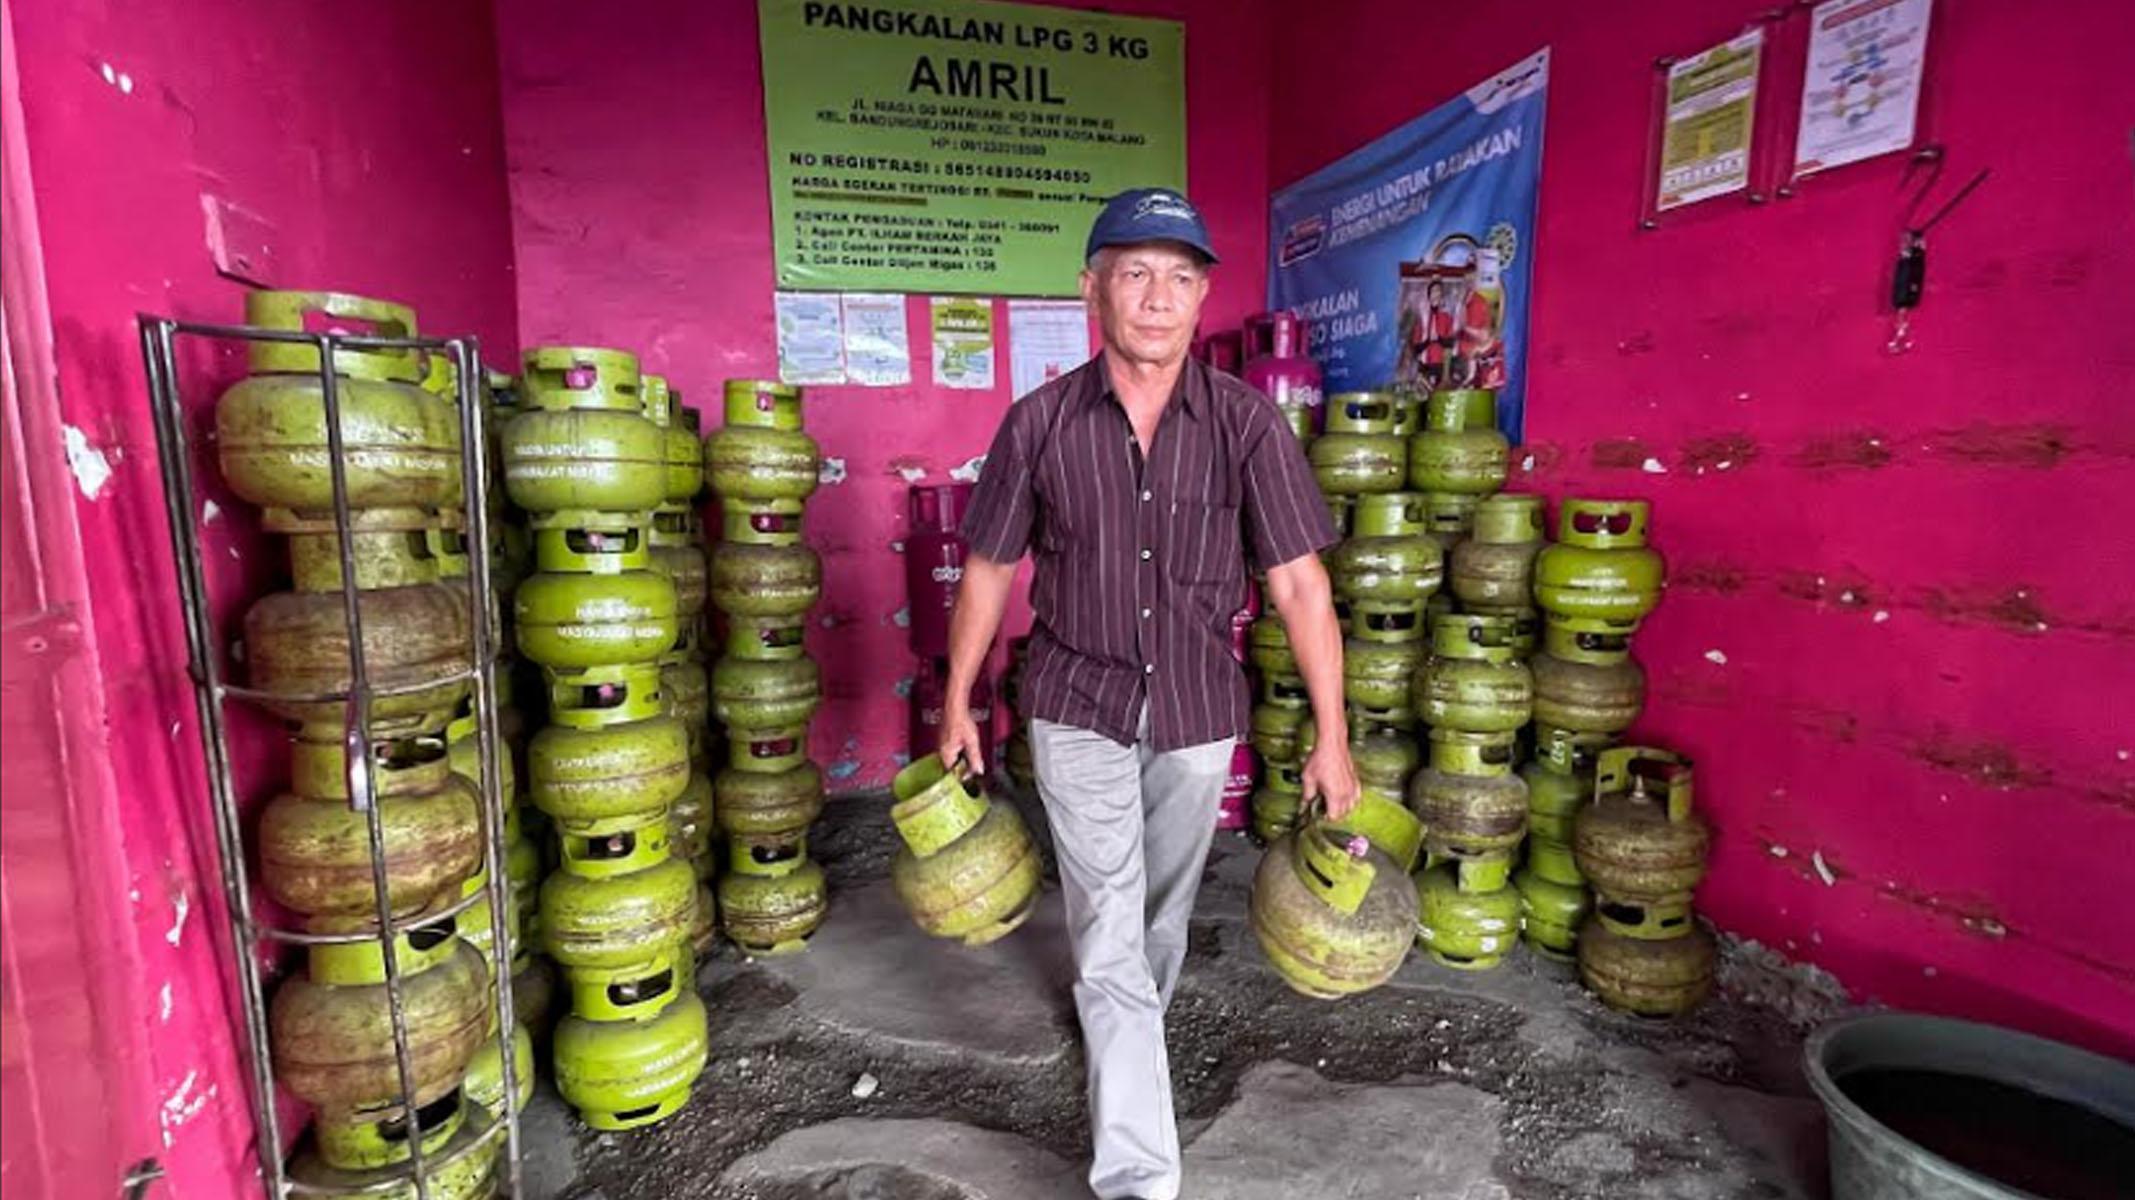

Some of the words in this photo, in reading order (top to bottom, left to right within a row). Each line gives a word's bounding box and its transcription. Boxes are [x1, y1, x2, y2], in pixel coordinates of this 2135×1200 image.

[802, 2, 1004, 45] PANGKALAN
[1015, 24, 1073, 52] LPG
[1082, 32, 1099, 55] 3
[1108, 35, 1150, 60] KG
[908, 55, 1066, 106] AMRIL
[789, 151, 817, 167] NO
[822, 153, 930, 175] REGISTRASI
[792, 176, 840, 188] HARGA
[1331, 188, 1377, 227] ENERGI
[1376, 166, 1432, 207] UNTUK
[1434, 124, 1523, 182] RAYAKAN
[794, 210, 849, 223] KONTAK
[854, 213, 934, 227] PENGADUAN
[812, 226, 844, 239] Agen
[916, 231, 969, 242] BERKAH
[974, 232, 1003, 245] JAYA
[887, 244, 961, 256] PERTAMINA
[1330, 310, 1378, 343] SIAGA
